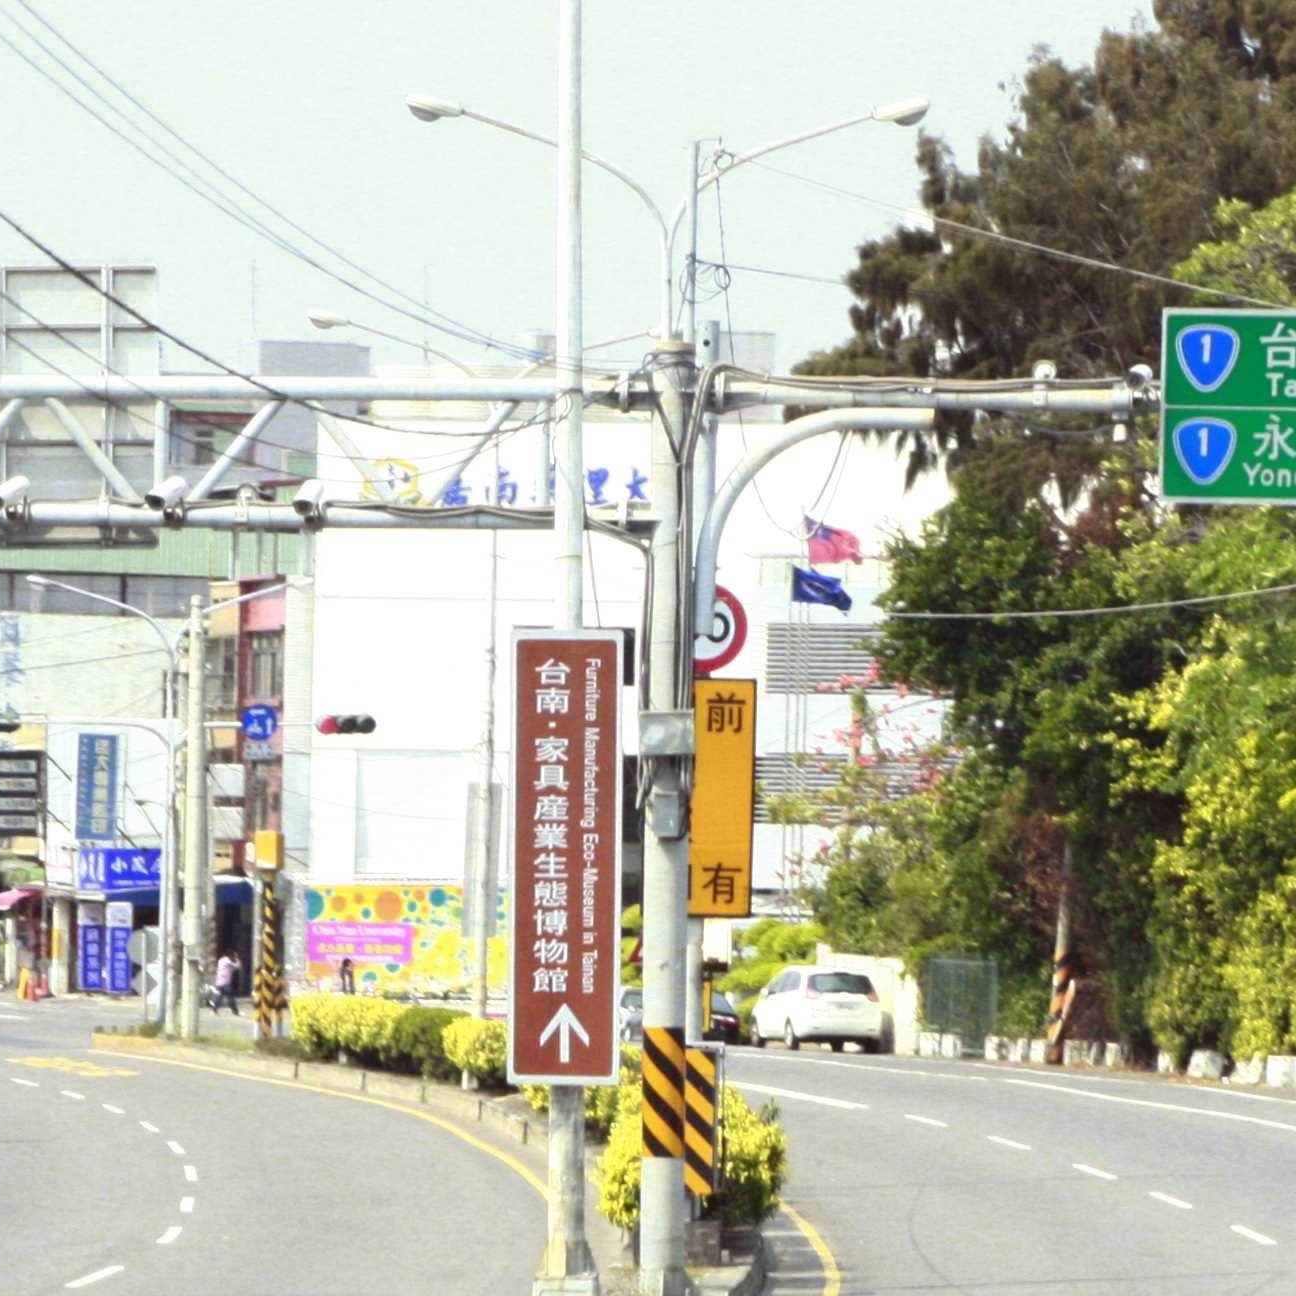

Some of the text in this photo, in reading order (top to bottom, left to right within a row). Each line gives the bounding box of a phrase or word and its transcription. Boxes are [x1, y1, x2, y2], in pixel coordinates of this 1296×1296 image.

[1200, 334, 1212, 364] 1
[1197, 427, 1209, 457] 1
[584, 658, 601, 722] Furniture
[581, 727, 600, 828] Manufacturing
[702, 692, 746, 905] 前 有
[582, 833, 599, 927] Eco-Museum
[582, 950, 598, 993] Tainan
